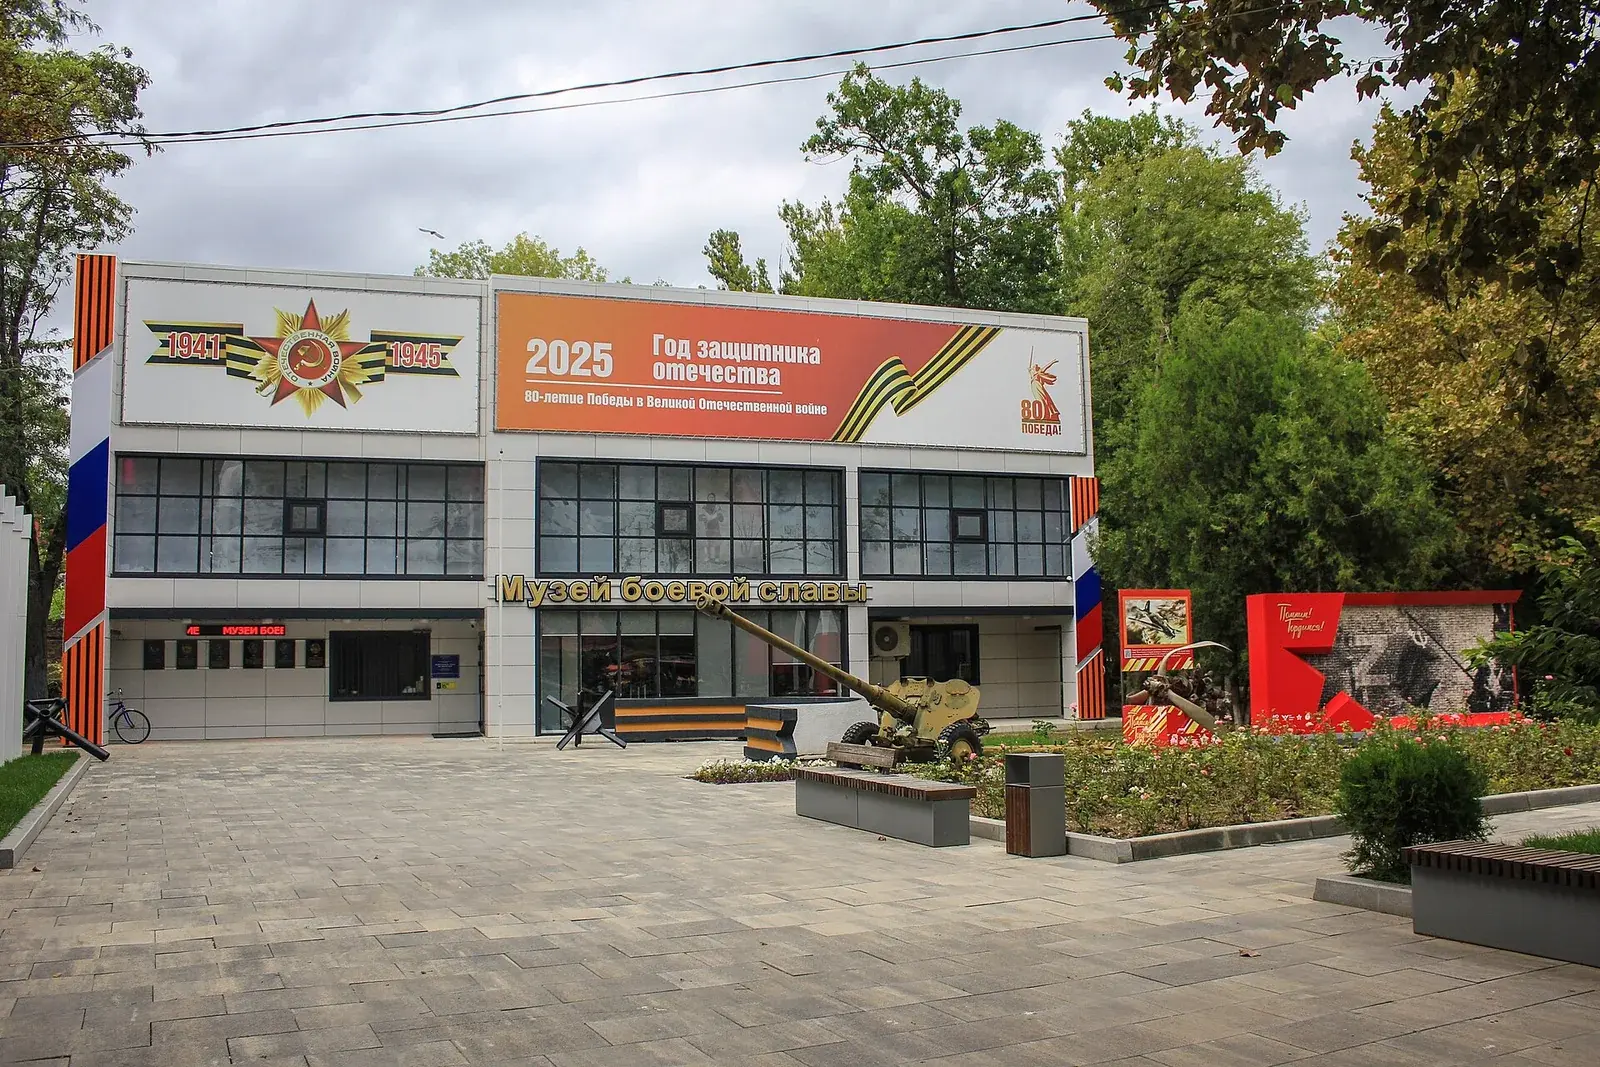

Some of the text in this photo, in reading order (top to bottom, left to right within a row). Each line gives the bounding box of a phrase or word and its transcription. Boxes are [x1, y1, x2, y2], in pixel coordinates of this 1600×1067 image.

[168, 331, 220, 360] 1941
[280, 331, 335, 382] ОТЕЧЕСТВЕННАЯ
[391, 341, 441, 369] 1945
[525, 337, 614, 378] 2025
[652, 333, 821, 365] Год защитника
[653, 361, 781, 386] отечества
[524, 390, 828, 415] 80-летие Победы в Великой Отечественной войне
[1021, 399, 1043, 420] 80
[1021, 423, 1062, 436] ПОБЕДА!
[495, 575, 868, 608] Музей боевой славы
